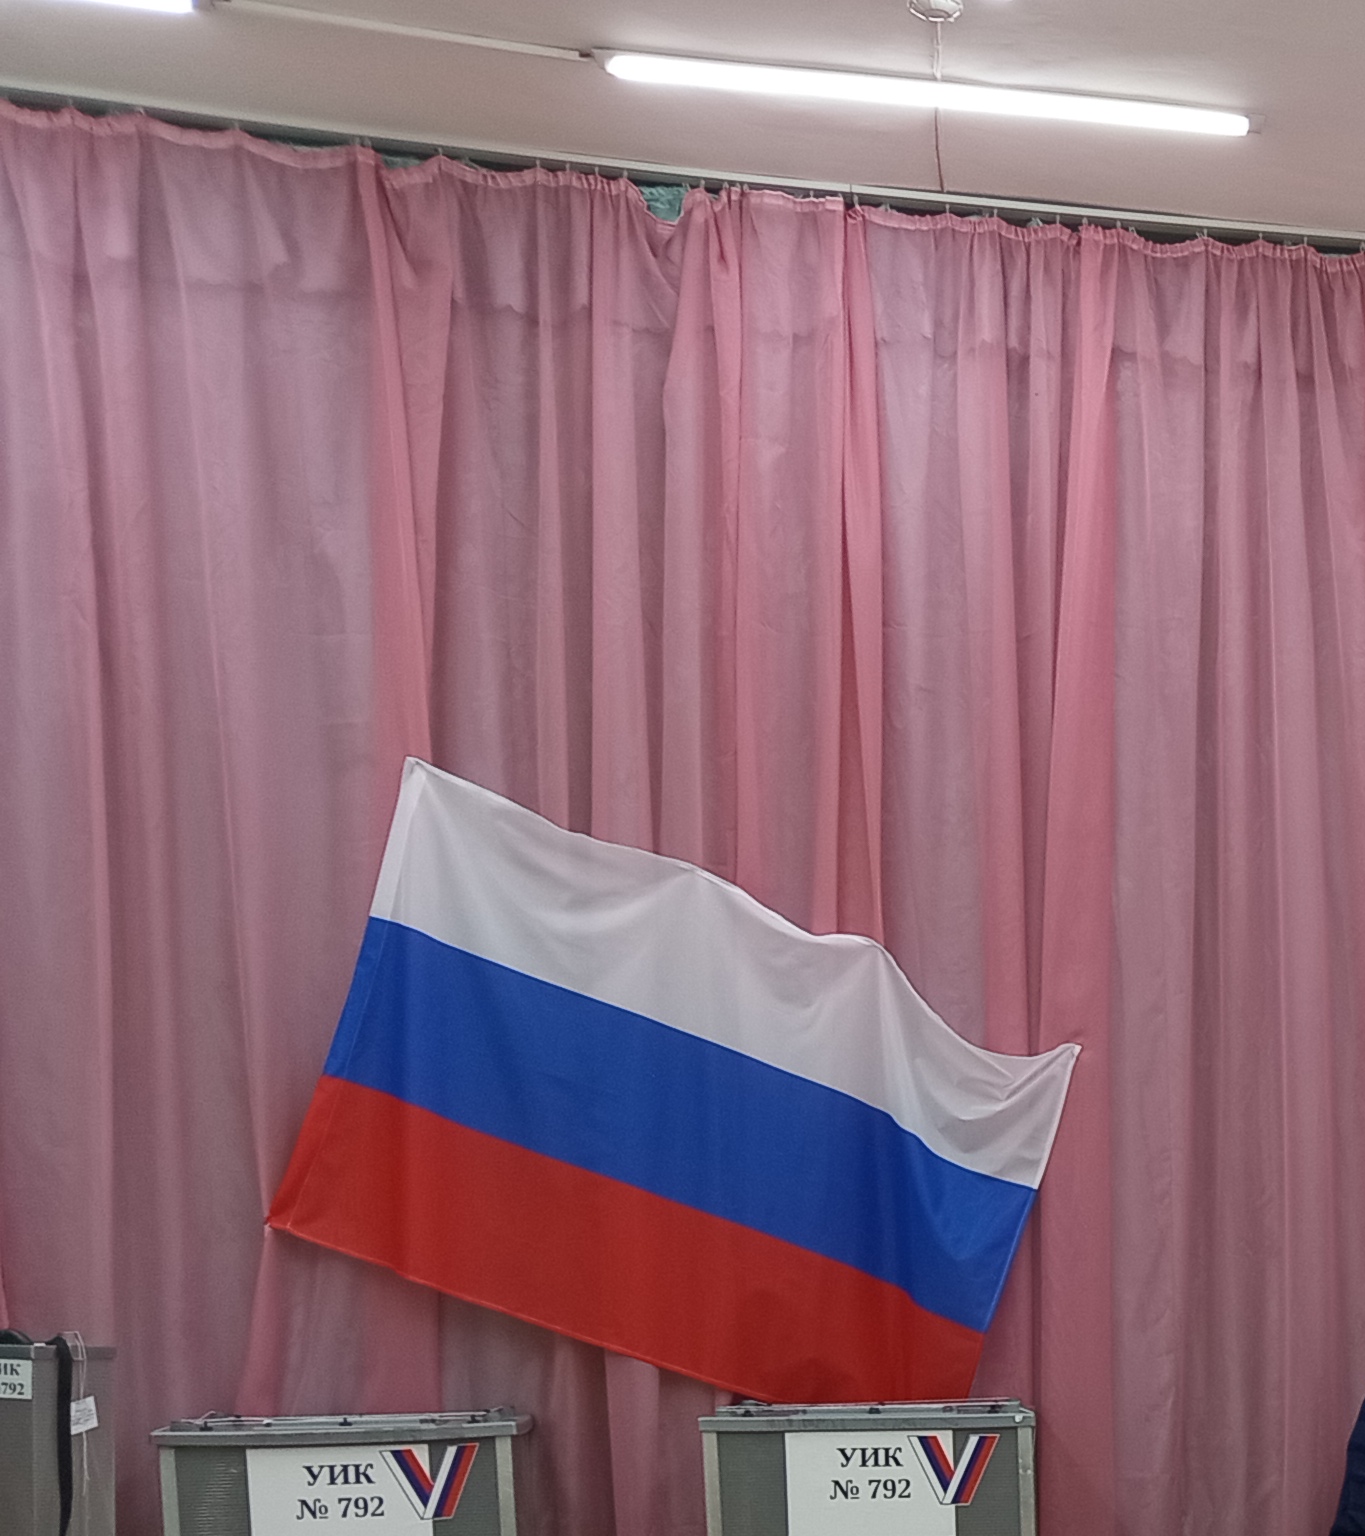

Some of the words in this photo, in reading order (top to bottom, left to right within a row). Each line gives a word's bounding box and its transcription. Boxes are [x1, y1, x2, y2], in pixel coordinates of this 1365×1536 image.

[1, 1382, 25, 1396] 792
[836, 1447, 904, 1468] УИК
[302, 1462, 376, 1487] УИК
[829, 1479, 860, 1500] №
[868, 1478, 912, 1500] 792
[296, 1498, 329, 1520] №
[337, 1496, 385, 1518] 792
